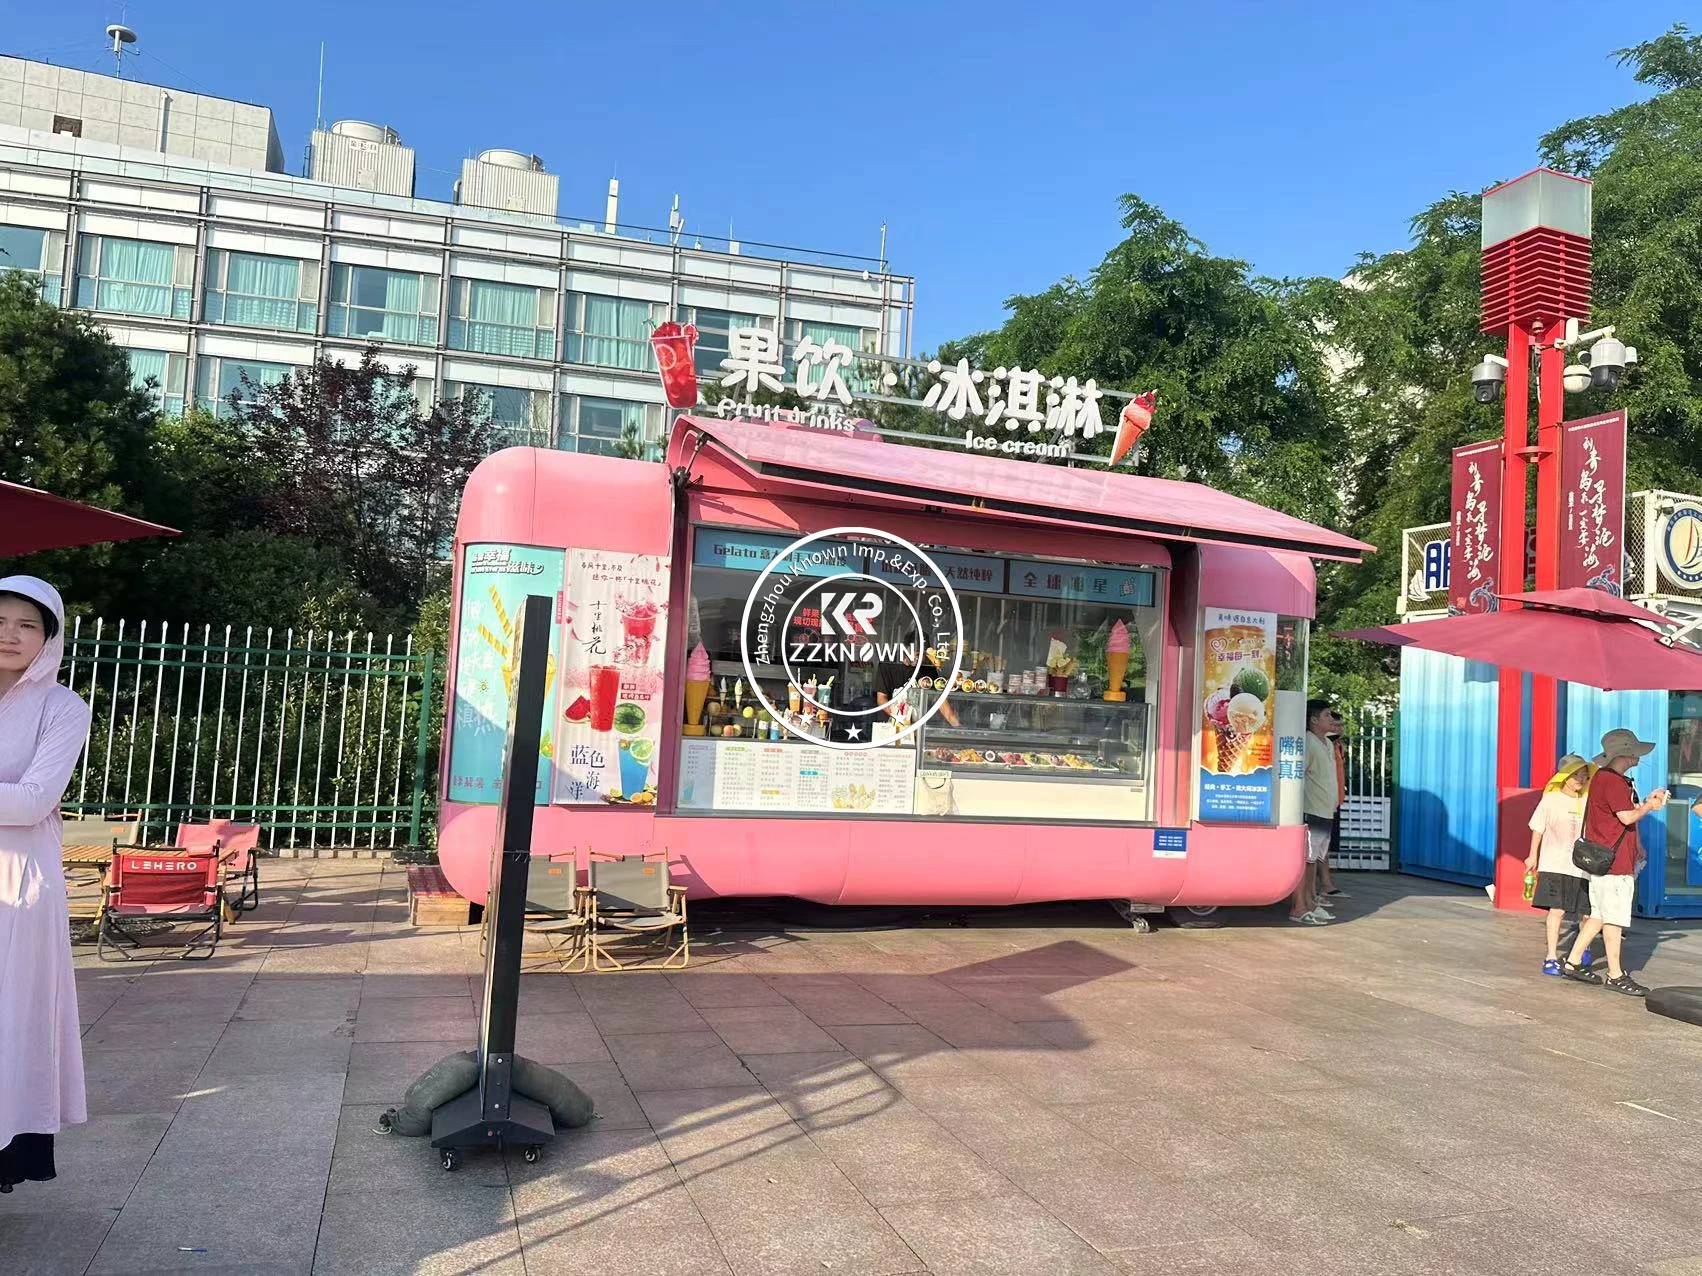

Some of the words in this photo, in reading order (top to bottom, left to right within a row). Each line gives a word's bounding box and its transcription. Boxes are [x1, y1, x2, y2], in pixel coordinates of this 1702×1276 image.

[787, 406, 855, 431] drinks
[966, 429, 997, 450] Ice
[1001, 440, 1067, 457] cream
[713, 544, 756, 559] Gelato
[570, 745, 605, 768] 蓝色
